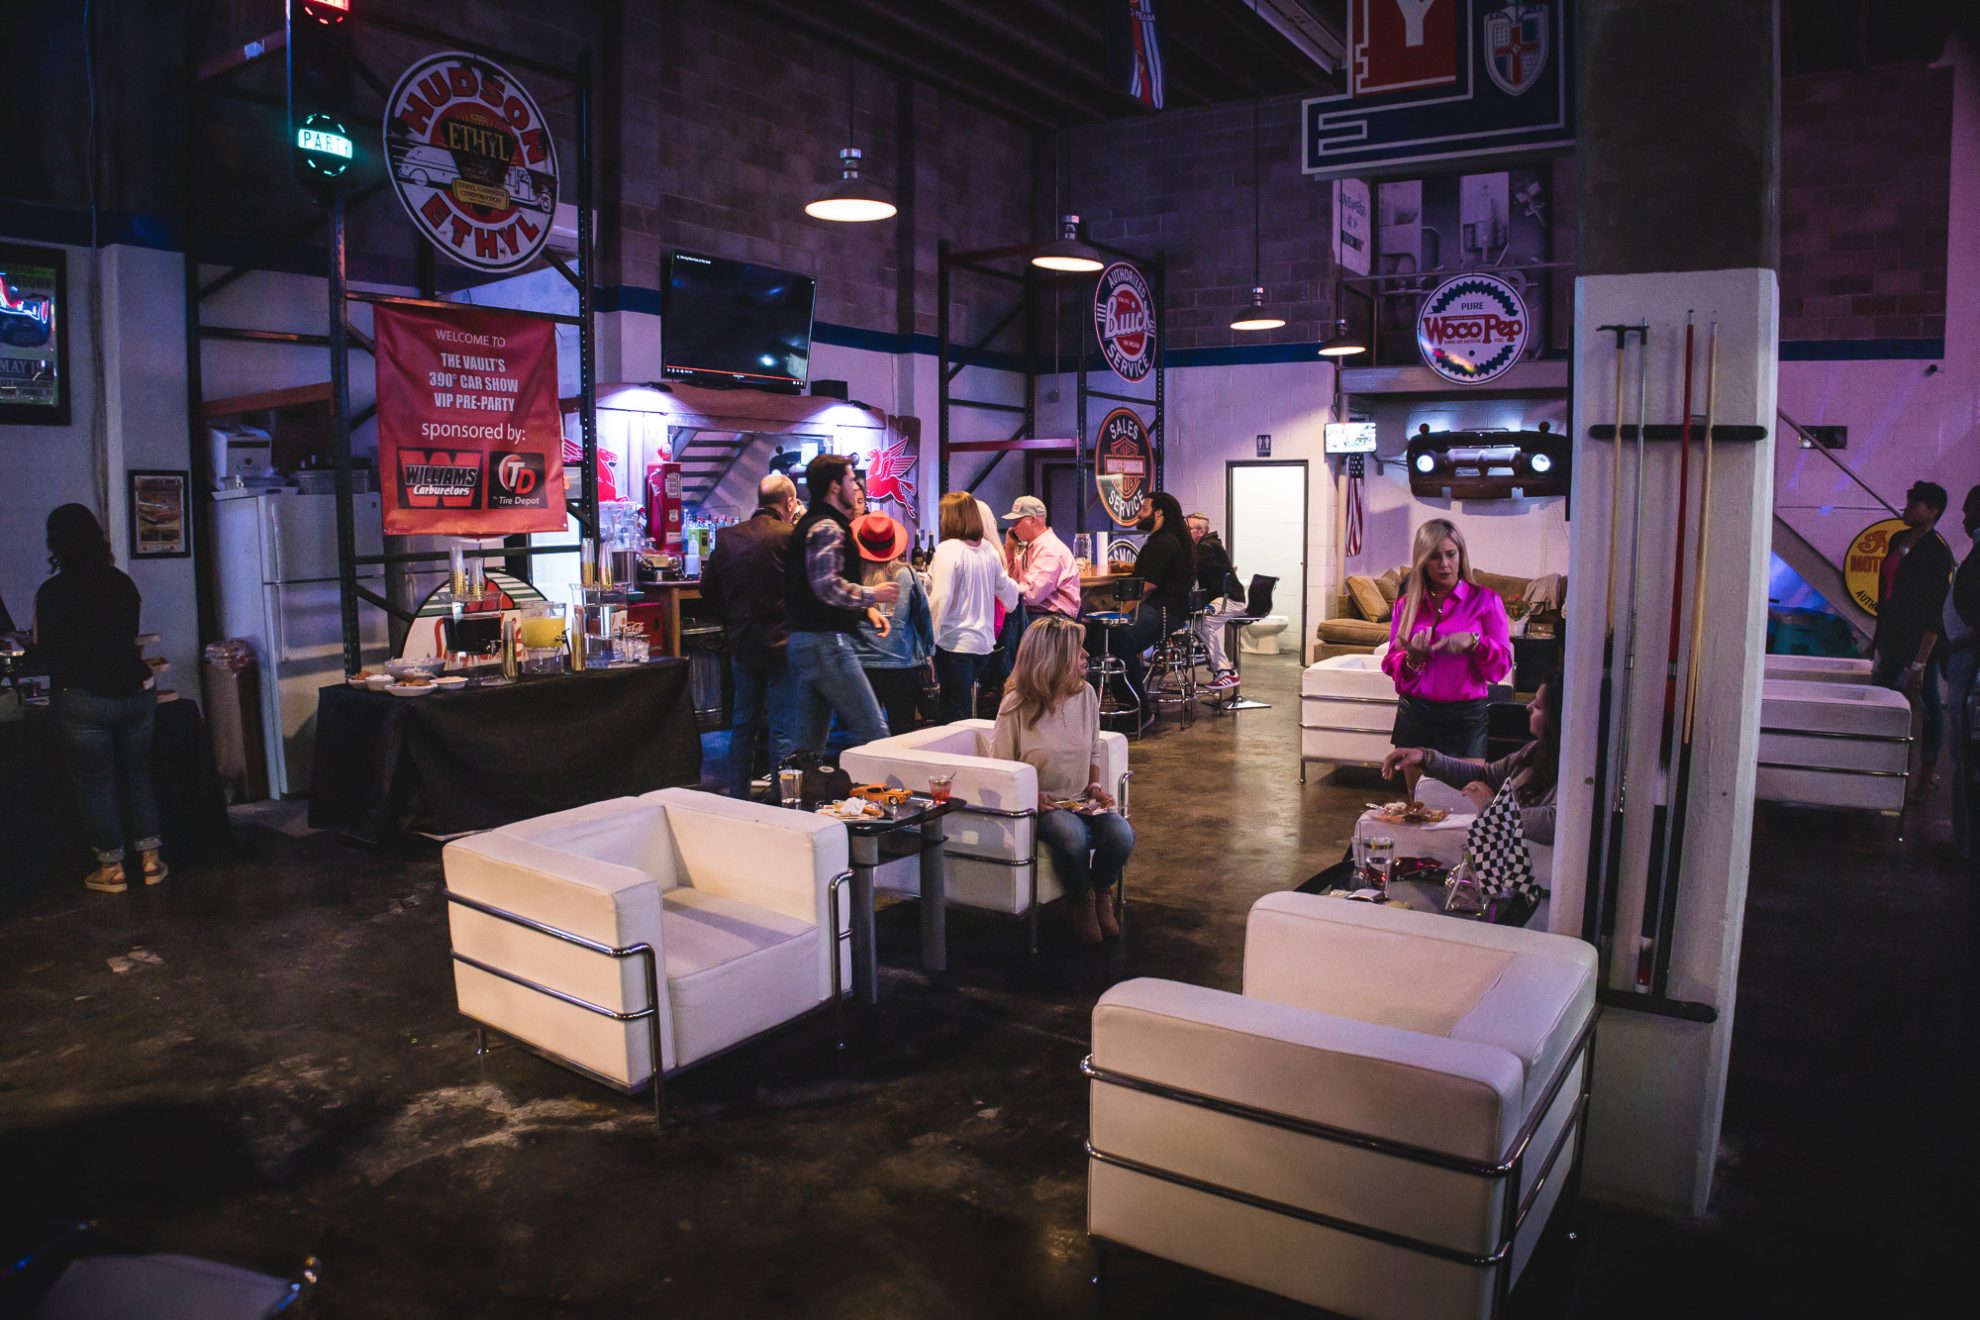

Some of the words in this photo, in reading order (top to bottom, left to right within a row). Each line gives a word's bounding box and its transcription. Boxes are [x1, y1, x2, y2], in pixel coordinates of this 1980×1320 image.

[401, 67, 547, 165] HUDSON
[448, 121, 510, 162] ETHYL
[420, 192, 540, 260] ETHYL
[1107, 268, 1147, 298] AUTHORIZED
[1104, 294, 1153, 339] Buick
[1461, 301, 1484, 310] PURE
[435, 329, 489, 346] WELCOME
[492, 336, 506, 348] TO
[1423, 316, 1482, 345] Woco
[1482, 313, 1523, 344] Pep
[441, 352, 461, 368] THE
[463, 355, 506, 373] VAULT'S
[1107, 343, 1149, 378] SERVICE
[429, 372, 458, 388] 390°
[460, 374, 483, 390] CAR
[485, 377, 519, 393] SHOW
[434, 392, 454, 408] VIP
[456, 393, 515, 412] PRE-PARTY
[421, 422, 504, 441] sponsored
[507, 424, 527, 445] by:
[1109, 419, 1139, 440] SALES
[405, 464, 478, 487] WILLIAMS
[507, 461, 537, 495] TD
[413, 484, 470, 496] Carburetors
[499, 495, 513, 505] Tire
[514, 496, 540, 507] Depot
[1109, 489, 1145, 518] SERVICE
